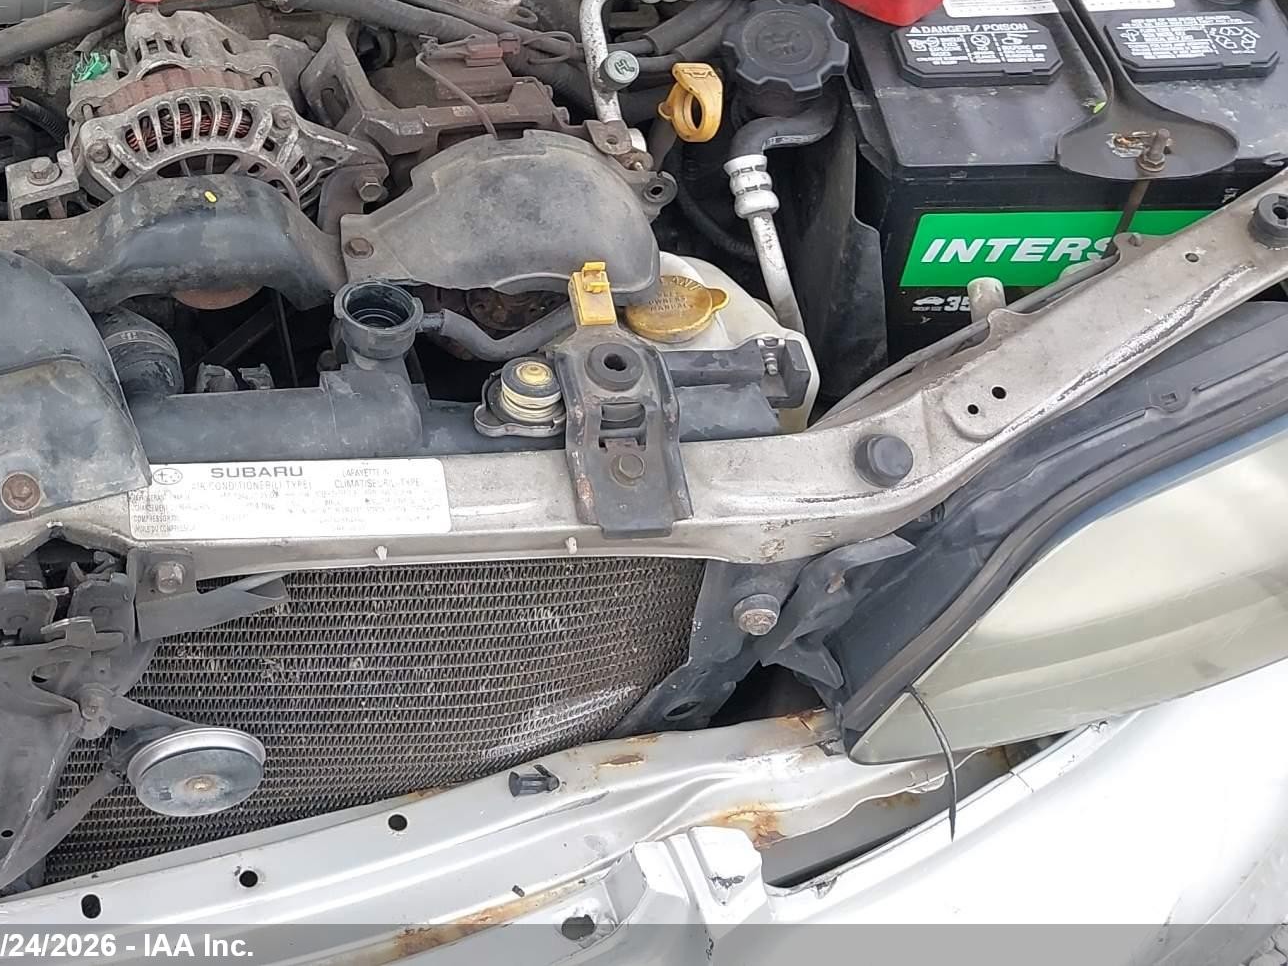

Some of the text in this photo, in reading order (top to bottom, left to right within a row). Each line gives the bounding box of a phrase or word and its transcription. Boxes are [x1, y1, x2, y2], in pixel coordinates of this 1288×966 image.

[920, 25, 972, 34] DANGER
[982, 22, 1029, 32] POISON
[210, 466, 304, 479] SUBARU
